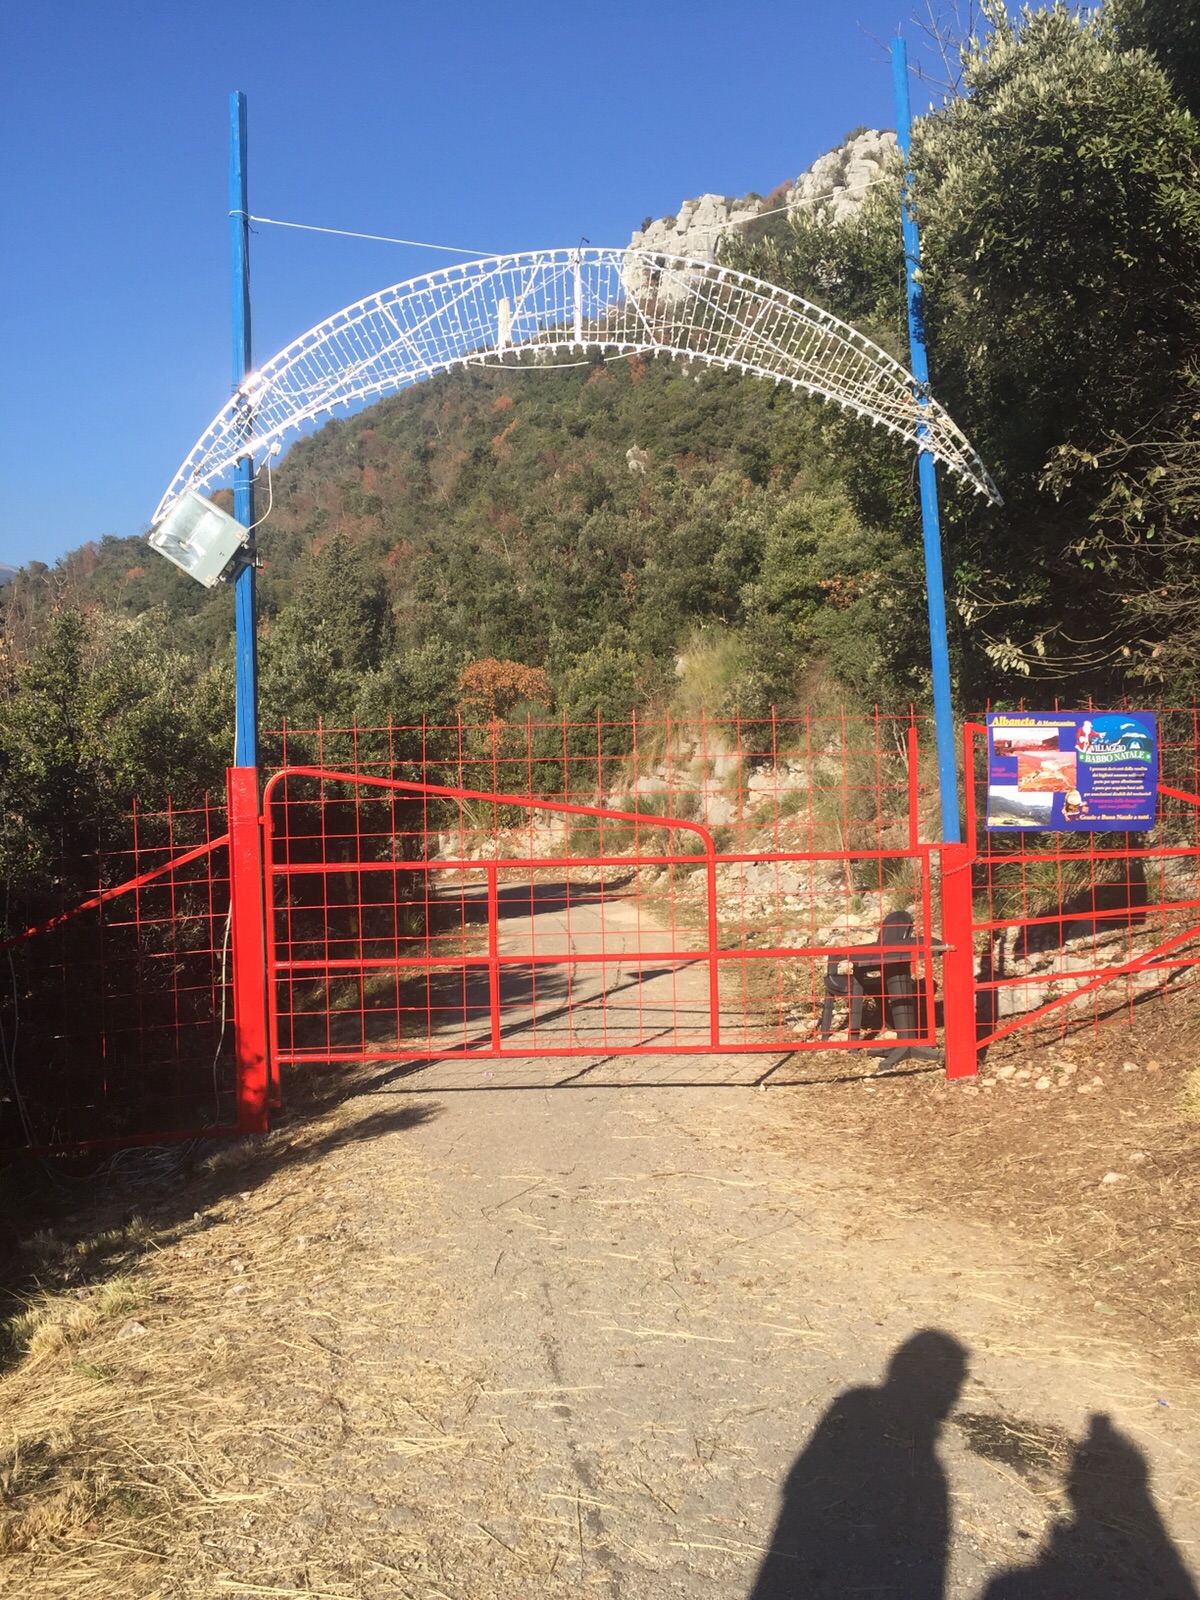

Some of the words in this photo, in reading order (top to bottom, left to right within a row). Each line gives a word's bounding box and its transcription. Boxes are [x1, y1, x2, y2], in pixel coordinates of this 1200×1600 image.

[991, 716, 1035, 726] Albaneta
[1090, 744, 1126, 752] VILLAGGIO
[1085, 754, 1113, 763] BABBO
[1114, 751, 1145, 761] NATALE
